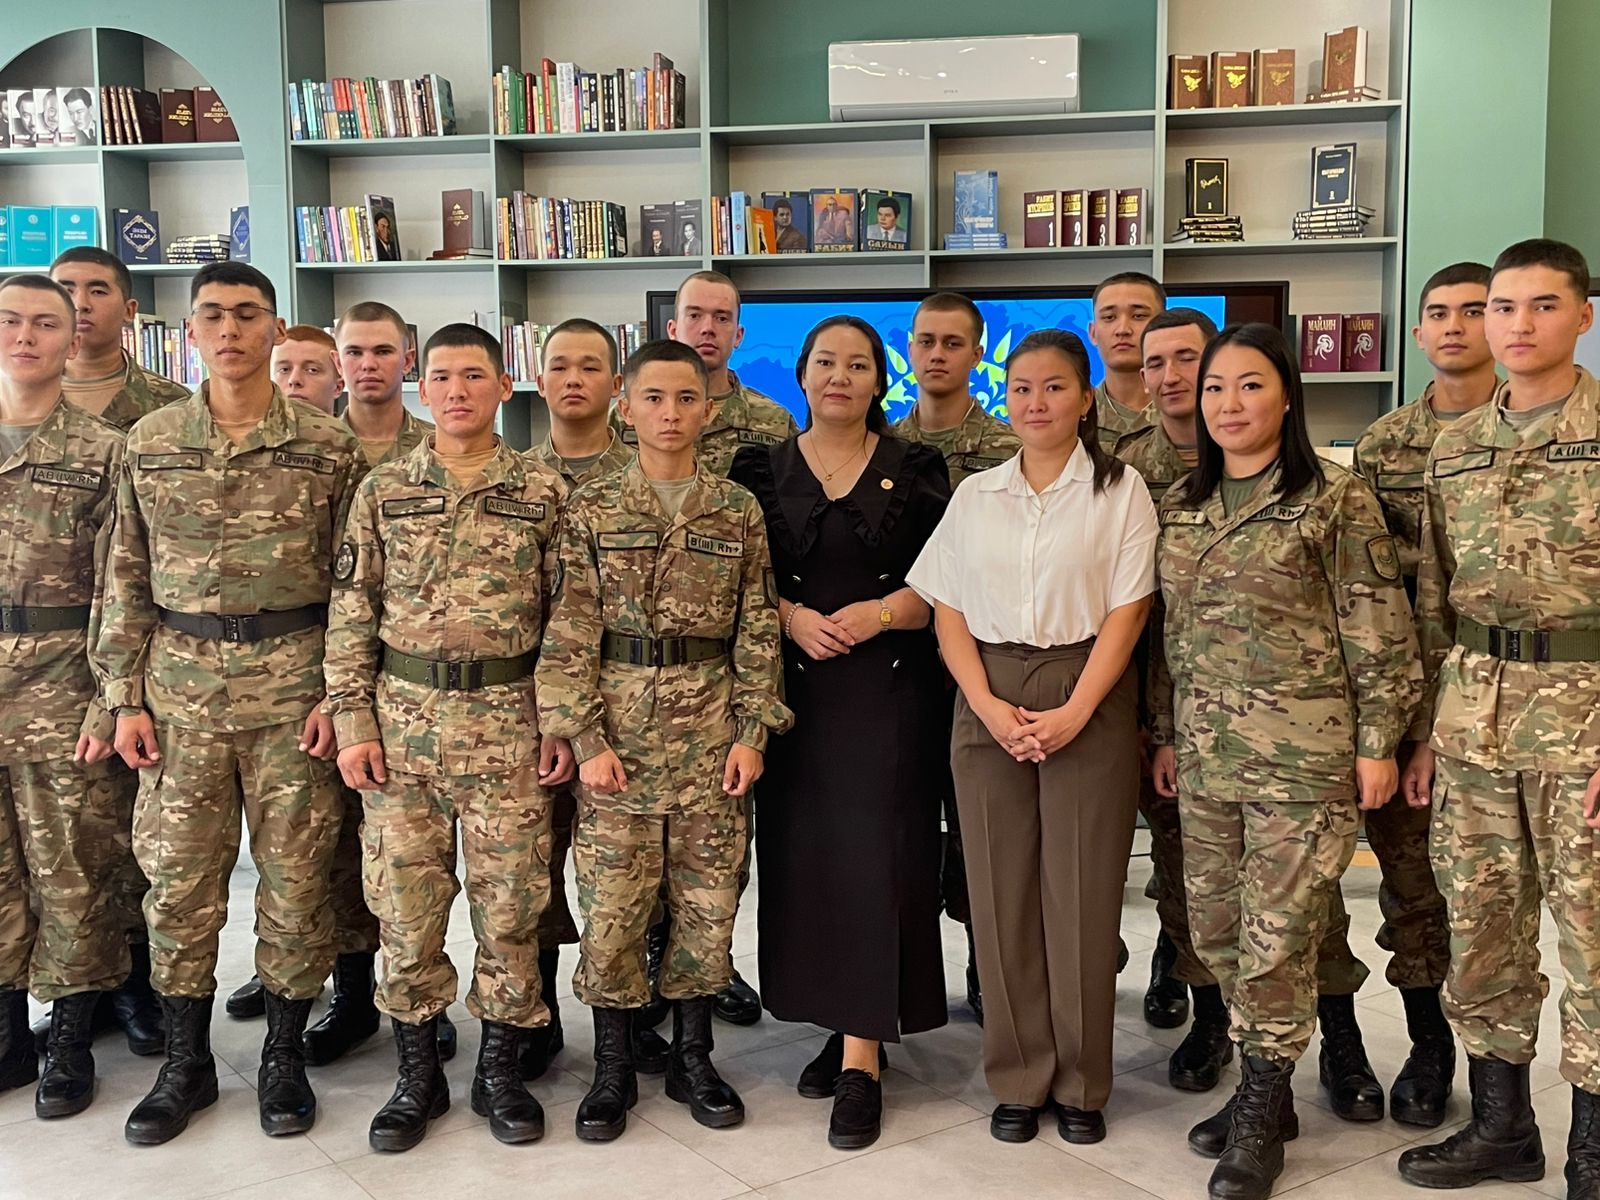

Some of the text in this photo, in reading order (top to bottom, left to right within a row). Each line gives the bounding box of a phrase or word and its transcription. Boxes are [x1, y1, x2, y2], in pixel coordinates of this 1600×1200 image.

[1048, 222, 1054, 246] 1
[1074, 221, 1081, 246] 2
[1099, 224, 1106, 246] 3
[1129, 223, 1137, 246] 3
